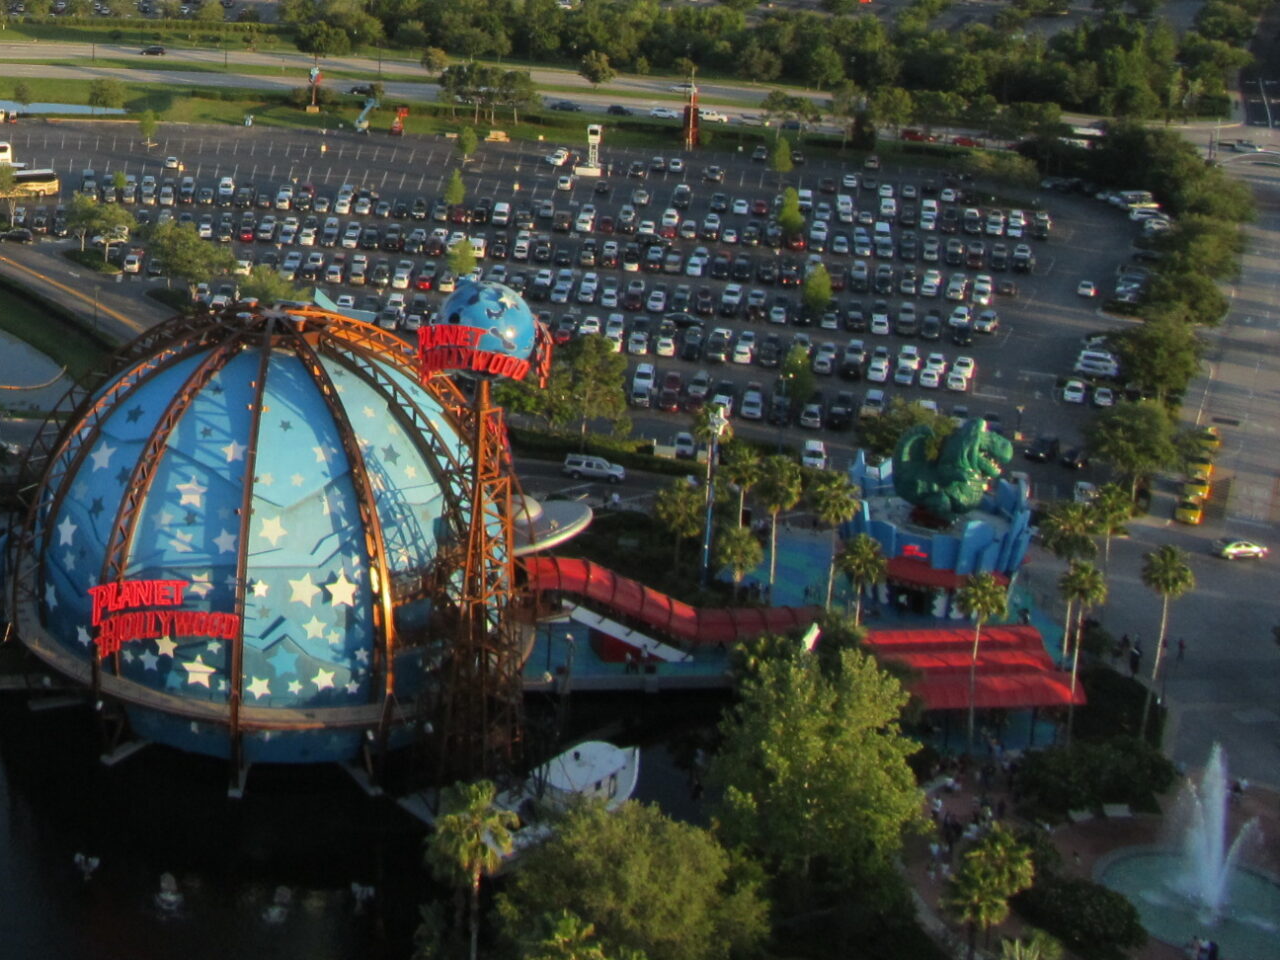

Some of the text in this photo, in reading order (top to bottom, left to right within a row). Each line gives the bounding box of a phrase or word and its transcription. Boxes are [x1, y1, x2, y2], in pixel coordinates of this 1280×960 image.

[417, 324, 488, 359] PLANET
[421, 347, 531, 385] HOLLYWOOD
[88, 580, 190, 626] PLANET
[94, 611, 240, 659] HOLLYWOOD
